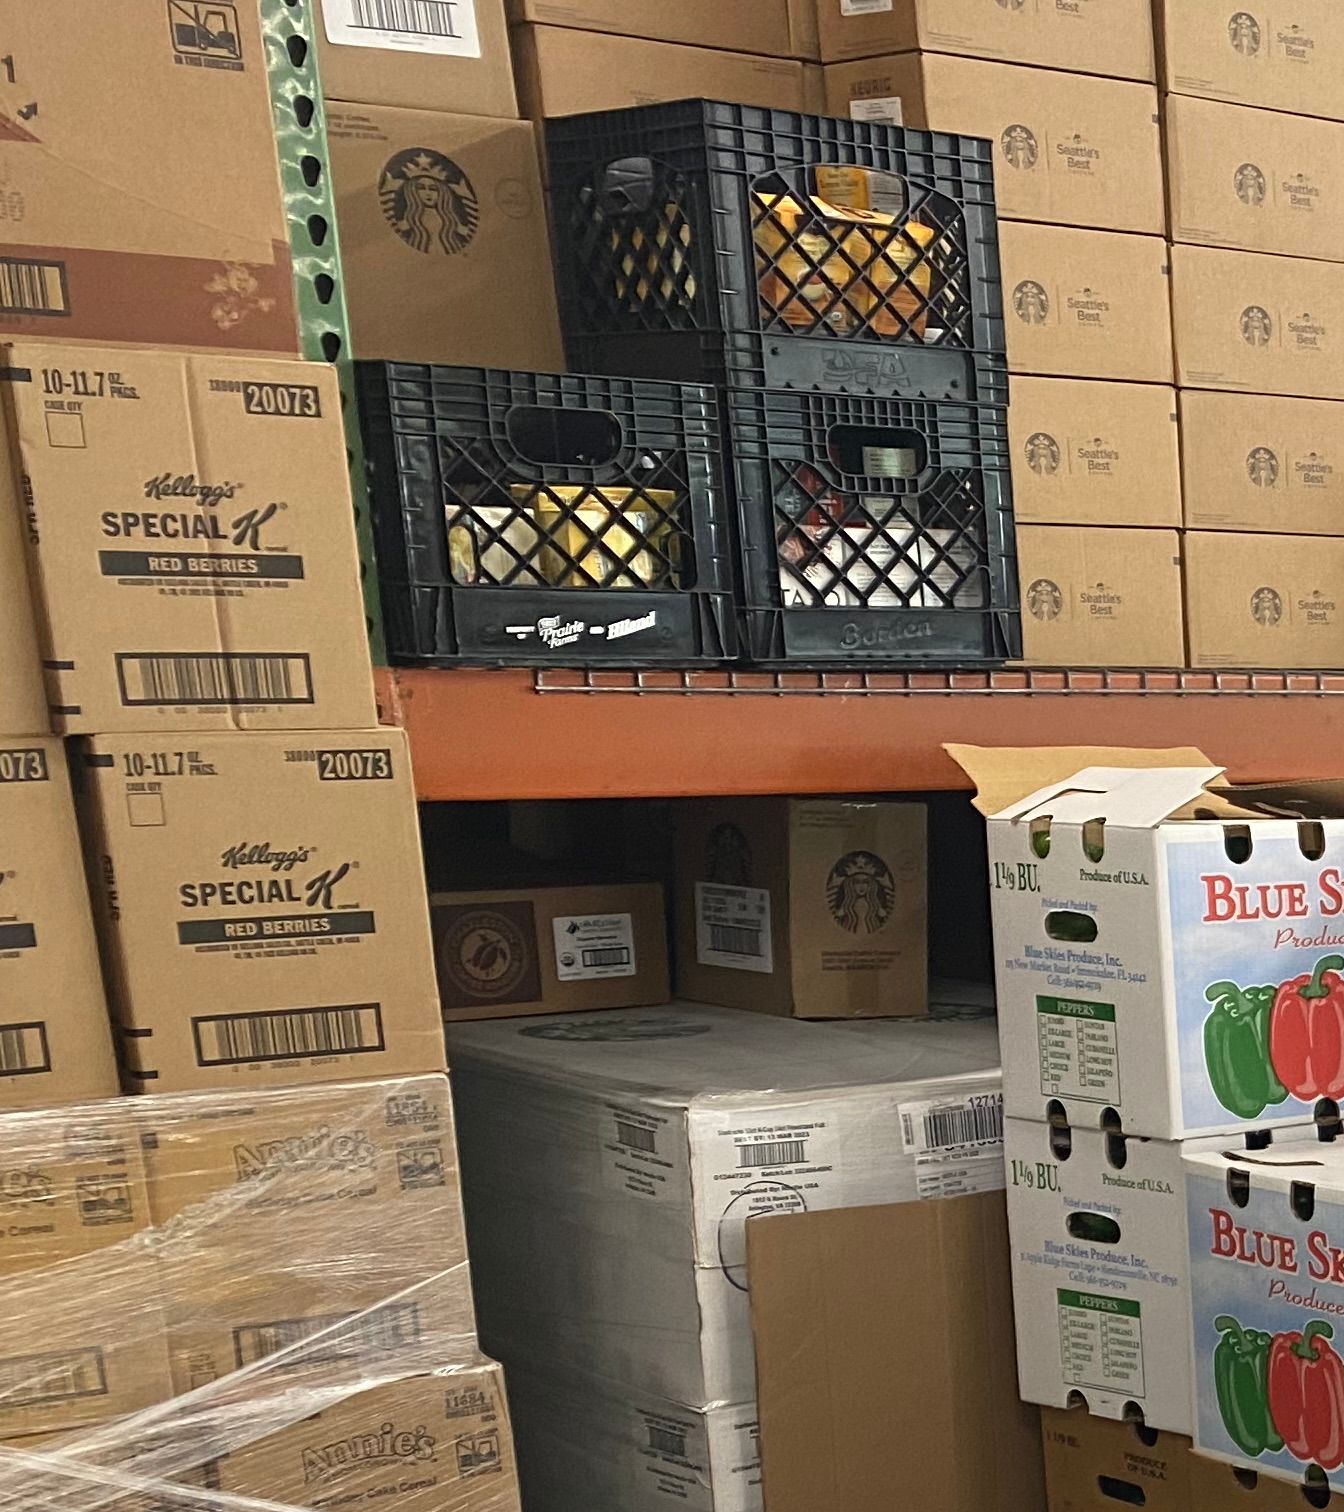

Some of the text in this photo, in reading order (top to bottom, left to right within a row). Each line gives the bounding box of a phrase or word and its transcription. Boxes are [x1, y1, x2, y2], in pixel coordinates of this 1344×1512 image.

[42, 369, 104, 397] 10-11.7
[248, 385, 316, 414] 20073
[1088, 460, 1110, 471] Best
[144, 473, 235, 507] Kellogg's
[101, 502, 277, 551] SPECIAL K
[149, 557, 258, 573] RED BERRIES
[1307, 611, 1327, 621] Best
[124, 752, 184, 776] 10-11.7
[322, 752, 388, 778] 20073
[222, 842, 309, 872] Kellogg's
[180, 863, 349, 910] SPECIAL K
[1018, 863, 1040, 892] BU.
[1080, 869, 1112, 883] Produce
[225, 919, 331, 937] RED BERRIES
[1036, 1163, 1061, 1192] BU.
[1102, 1173, 1135, 1190] Produce
[1268, 1279, 1344, 1315] Produce
[302, 1423, 435, 1483] Annie's
